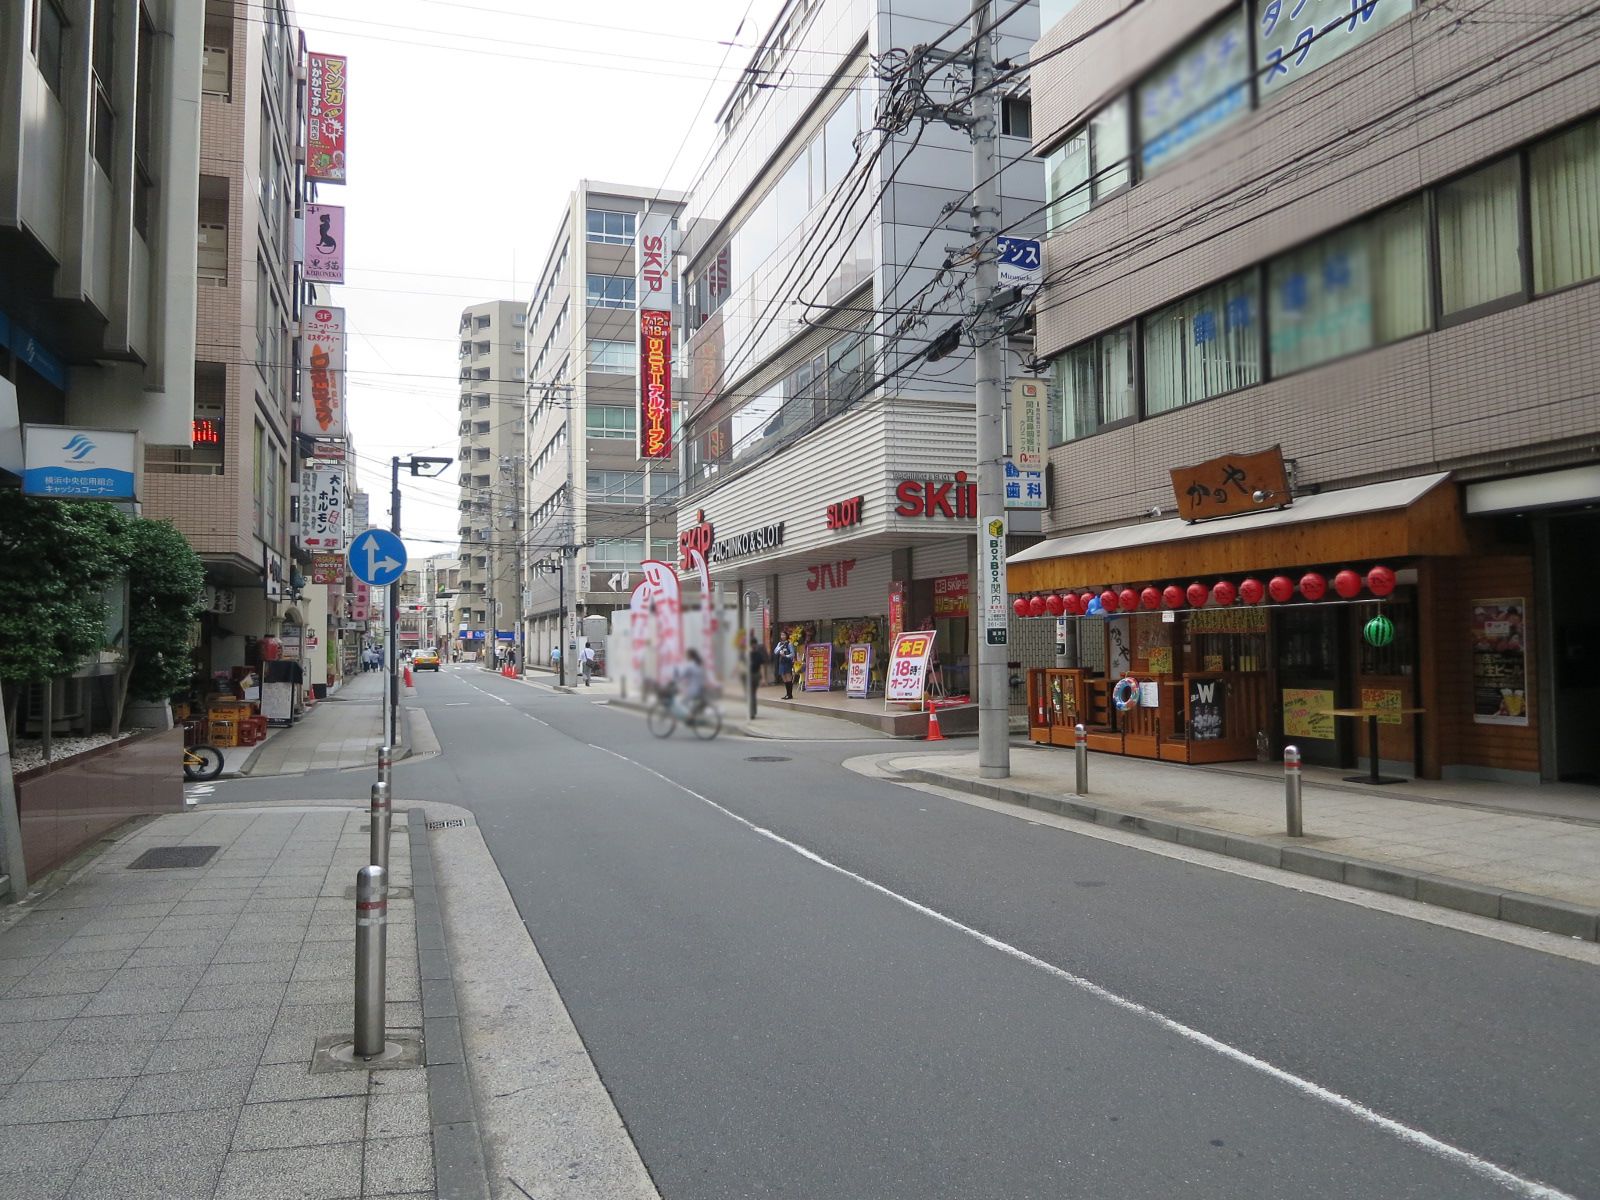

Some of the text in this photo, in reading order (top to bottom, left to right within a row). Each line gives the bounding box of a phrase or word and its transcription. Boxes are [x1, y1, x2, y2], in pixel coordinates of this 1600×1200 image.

[1006, 482, 1042, 499] 歯科
[317, 491, 328, 534] ホルモン
[827, 496, 862, 530] SLOT
[711, 532, 749, 562] PACHINKO
[749, 531, 757, 552] &
[757, 522, 782, 549] SLOT
[899, 640, 925, 656] 本日
